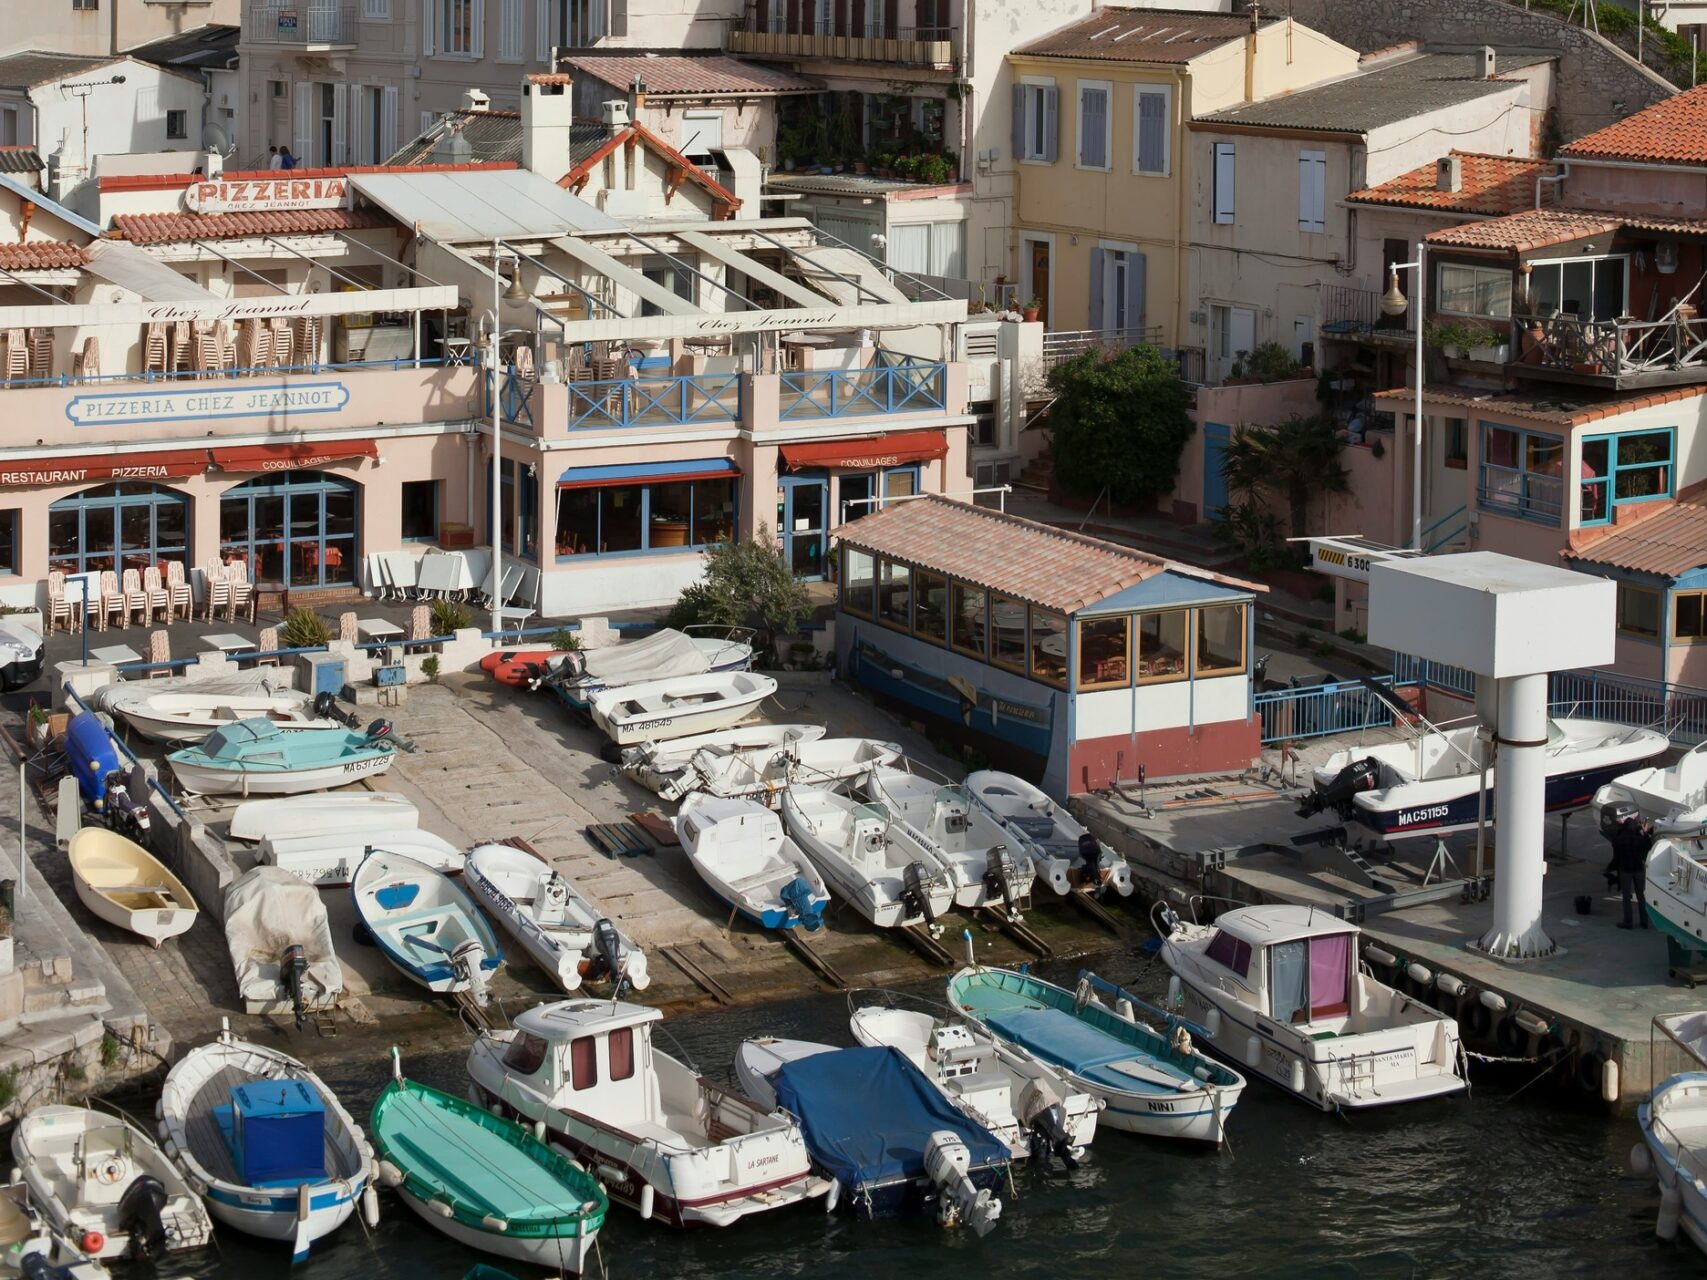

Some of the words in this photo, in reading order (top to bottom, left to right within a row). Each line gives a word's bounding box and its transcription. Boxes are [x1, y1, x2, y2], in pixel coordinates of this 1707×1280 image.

[198, 179, 347, 203] PIZZERIA
[264, 200, 311, 209] JEANNOT
[148, 304, 203, 320] Chez
[217, 299, 311, 320] Jeannot
[697, 318, 743, 331] Chez
[85, 399, 176, 417] PIZZERIA
[185, 395, 235, 412] CHEZ
[246, 391, 333, 409] JEANNOT
[262, 455, 331, 470] COQUILLAGES
[840, 456, 898, 468] COQUILLAGES
[1, 469, 88, 484] RESTAURANT
[111, 465, 169, 478] PIZZERIA
[1398, 804, 1449, 826] MAC51155
[1147, 1101, 1175, 1112] NINI
